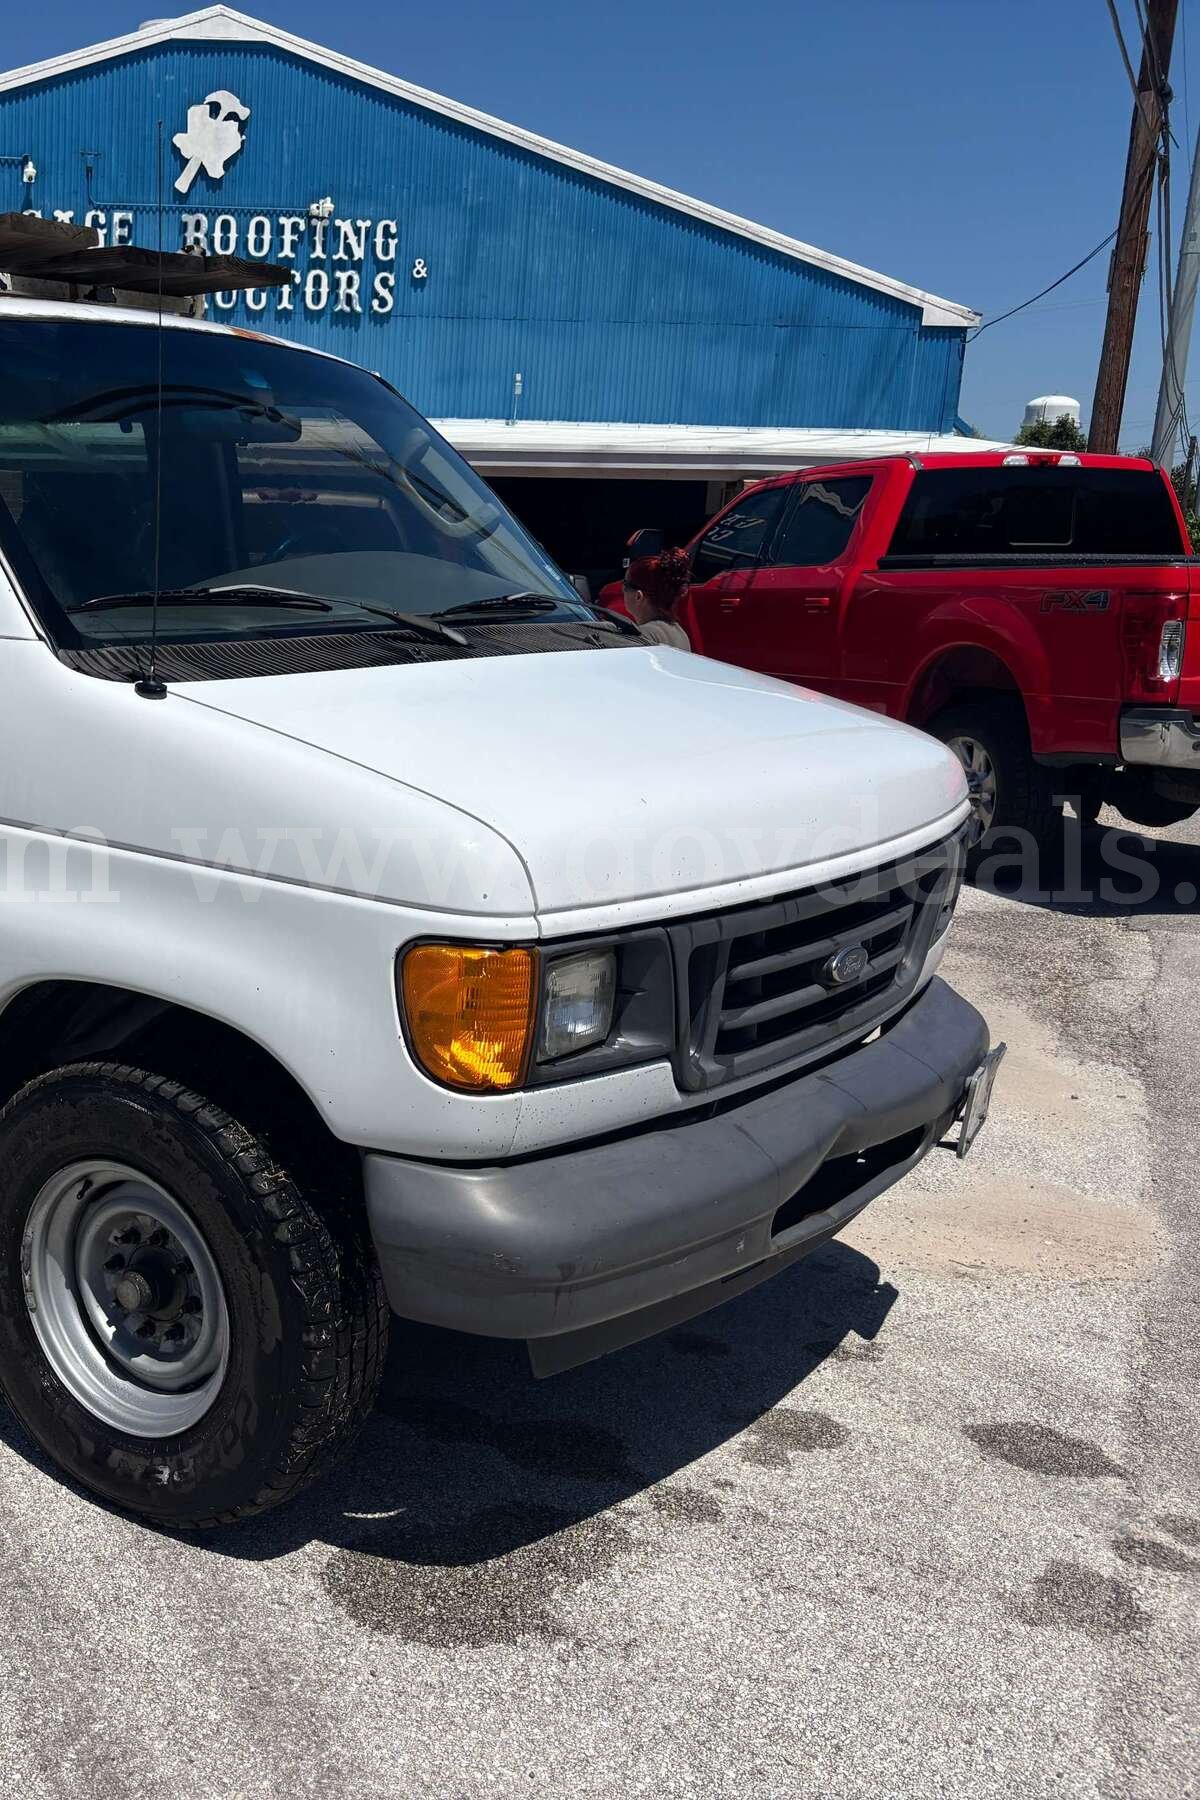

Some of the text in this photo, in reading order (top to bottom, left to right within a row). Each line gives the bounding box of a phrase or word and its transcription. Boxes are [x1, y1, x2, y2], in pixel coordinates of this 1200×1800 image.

[180, 211, 398, 263] ROOFING
[412, 257, 428, 279] &
[1040, 589, 1112, 615] FX4
